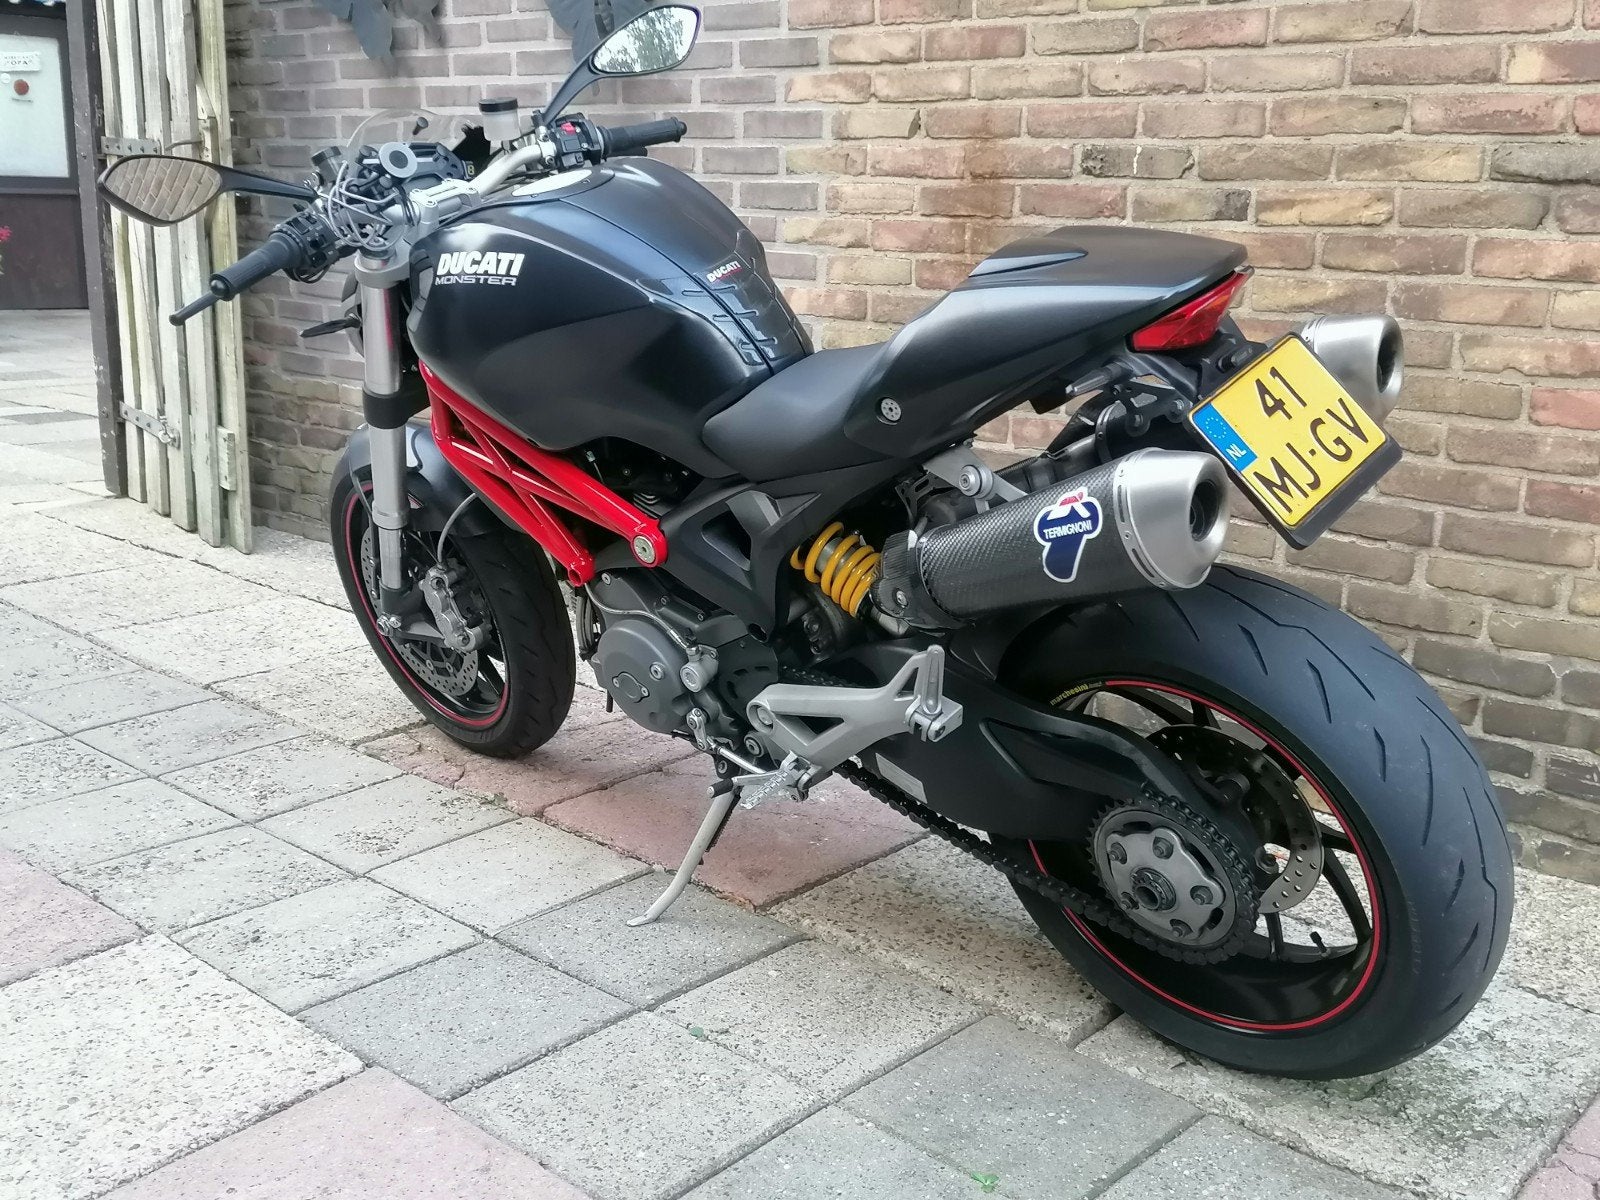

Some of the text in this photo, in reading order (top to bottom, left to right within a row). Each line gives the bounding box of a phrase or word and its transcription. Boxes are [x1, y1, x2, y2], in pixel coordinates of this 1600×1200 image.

[436, 250, 525, 276] DUCATI
[706, 260, 741, 283] DUCATI
[434, 275, 517, 286] MONSTER
[1255, 366, 1308, 421] 41
[1225, 442, 1247, 461] NL
[1252, 397, 1369, 514] MJ-GV
[1043, 519, 1093, 540] TERMIGNONI
